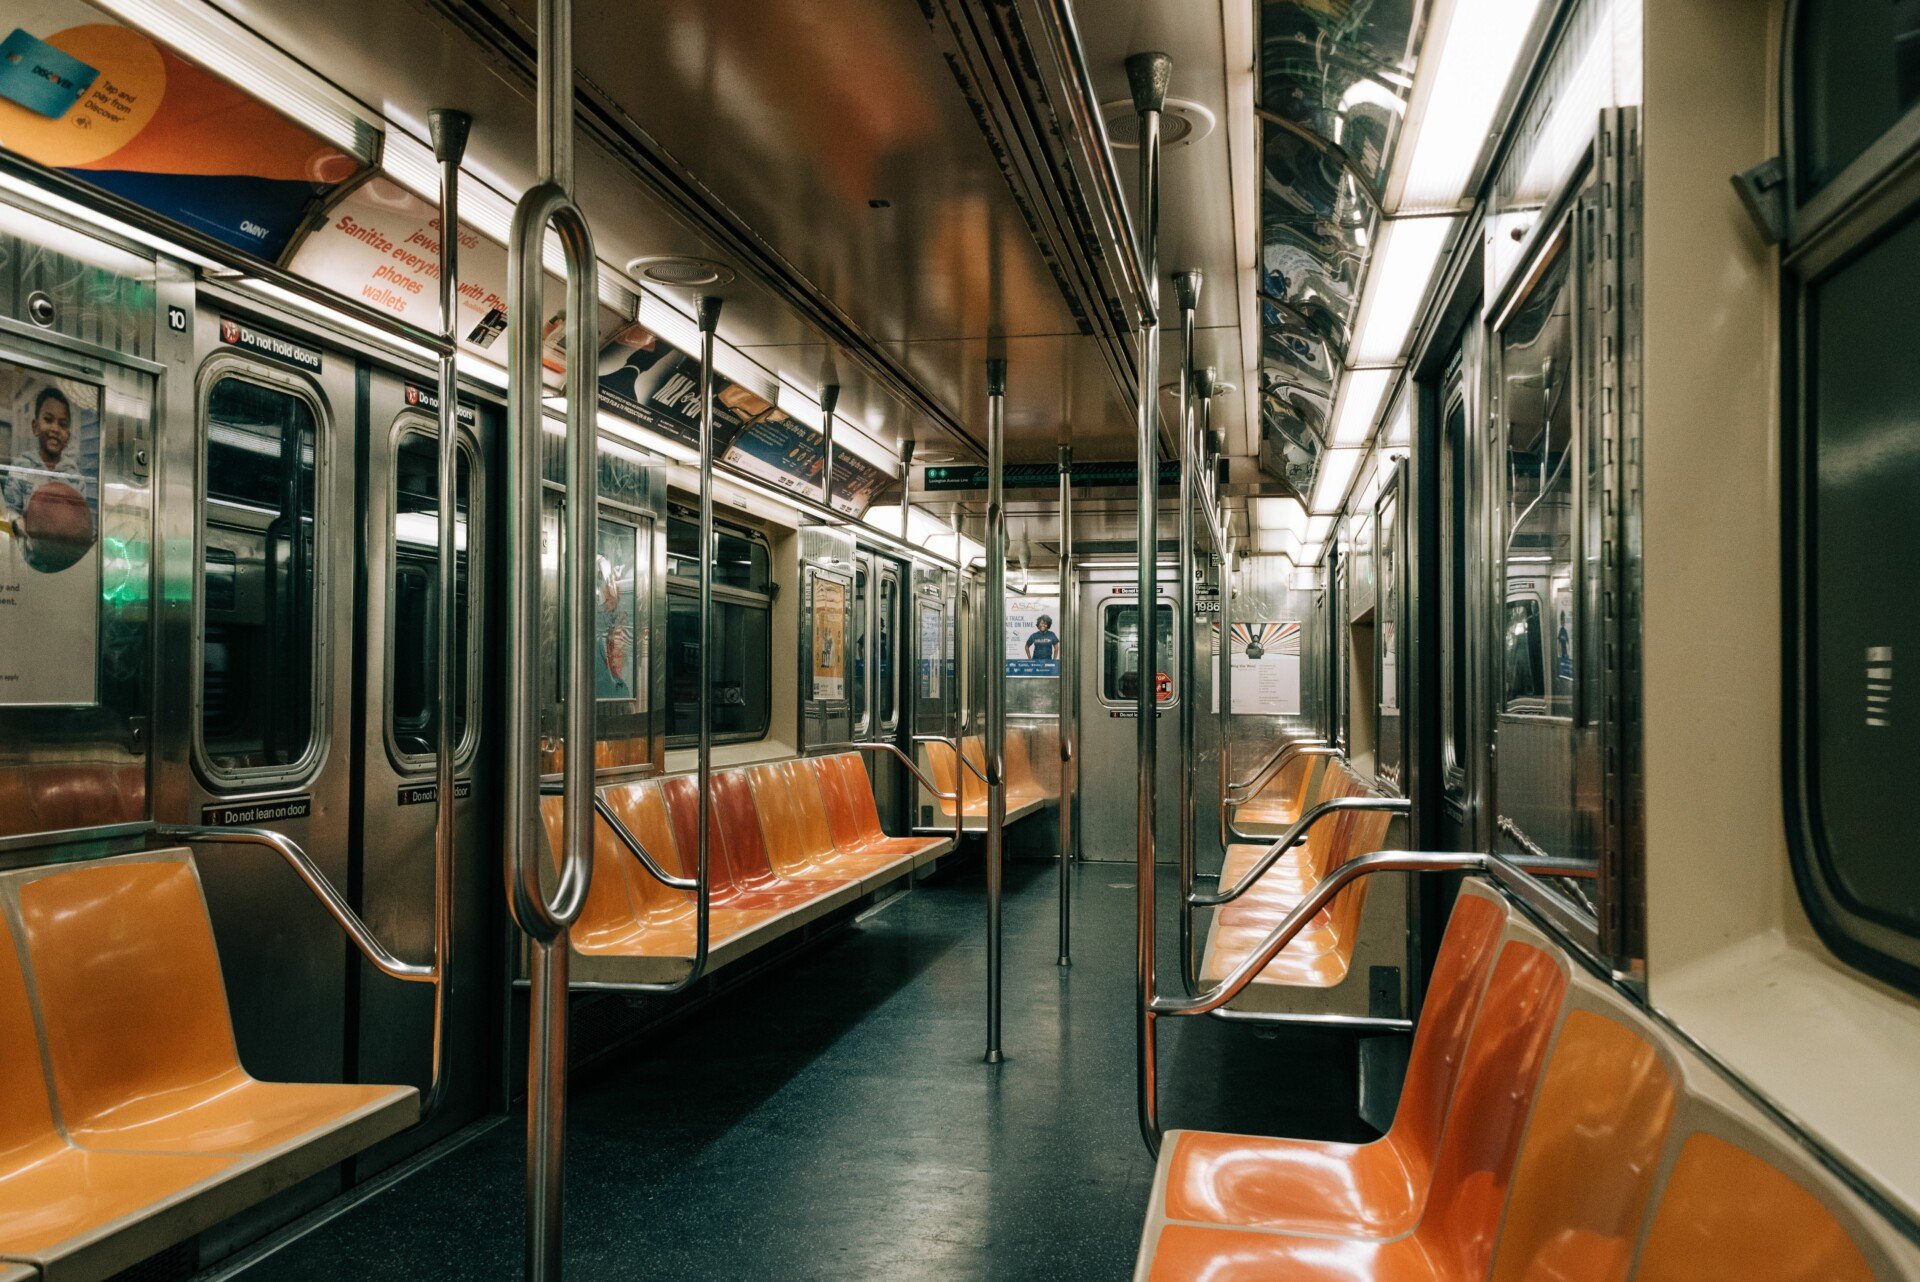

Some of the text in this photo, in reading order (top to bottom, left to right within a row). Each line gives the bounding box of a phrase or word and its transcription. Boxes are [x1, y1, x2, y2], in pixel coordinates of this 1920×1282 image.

[103, 80, 137, 103] Tap and
[92, 91, 132, 114] pay from
[239, 220, 270, 239] OMNY
[335, 215, 393, 254] Sanitize
[392, 248, 440, 281] everyth
[457, 281, 484, 301] with
[372, 263, 424, 295] phones
[362, 283, 408, 313] wallets
[169, 310, 185, 330] 10
[241, 329, 319, 367] Do not hold doors
[419, 391, 439, 408] Do no
[6, 584, 20, 592] and
[1195, 602, 1220, 612] 1986
[412, 791, 421, 802] Do
[422, 790, 433, 800] not
[454, 787, 468, 797] door
[225, 804, 307, 824] Do not lean on door
